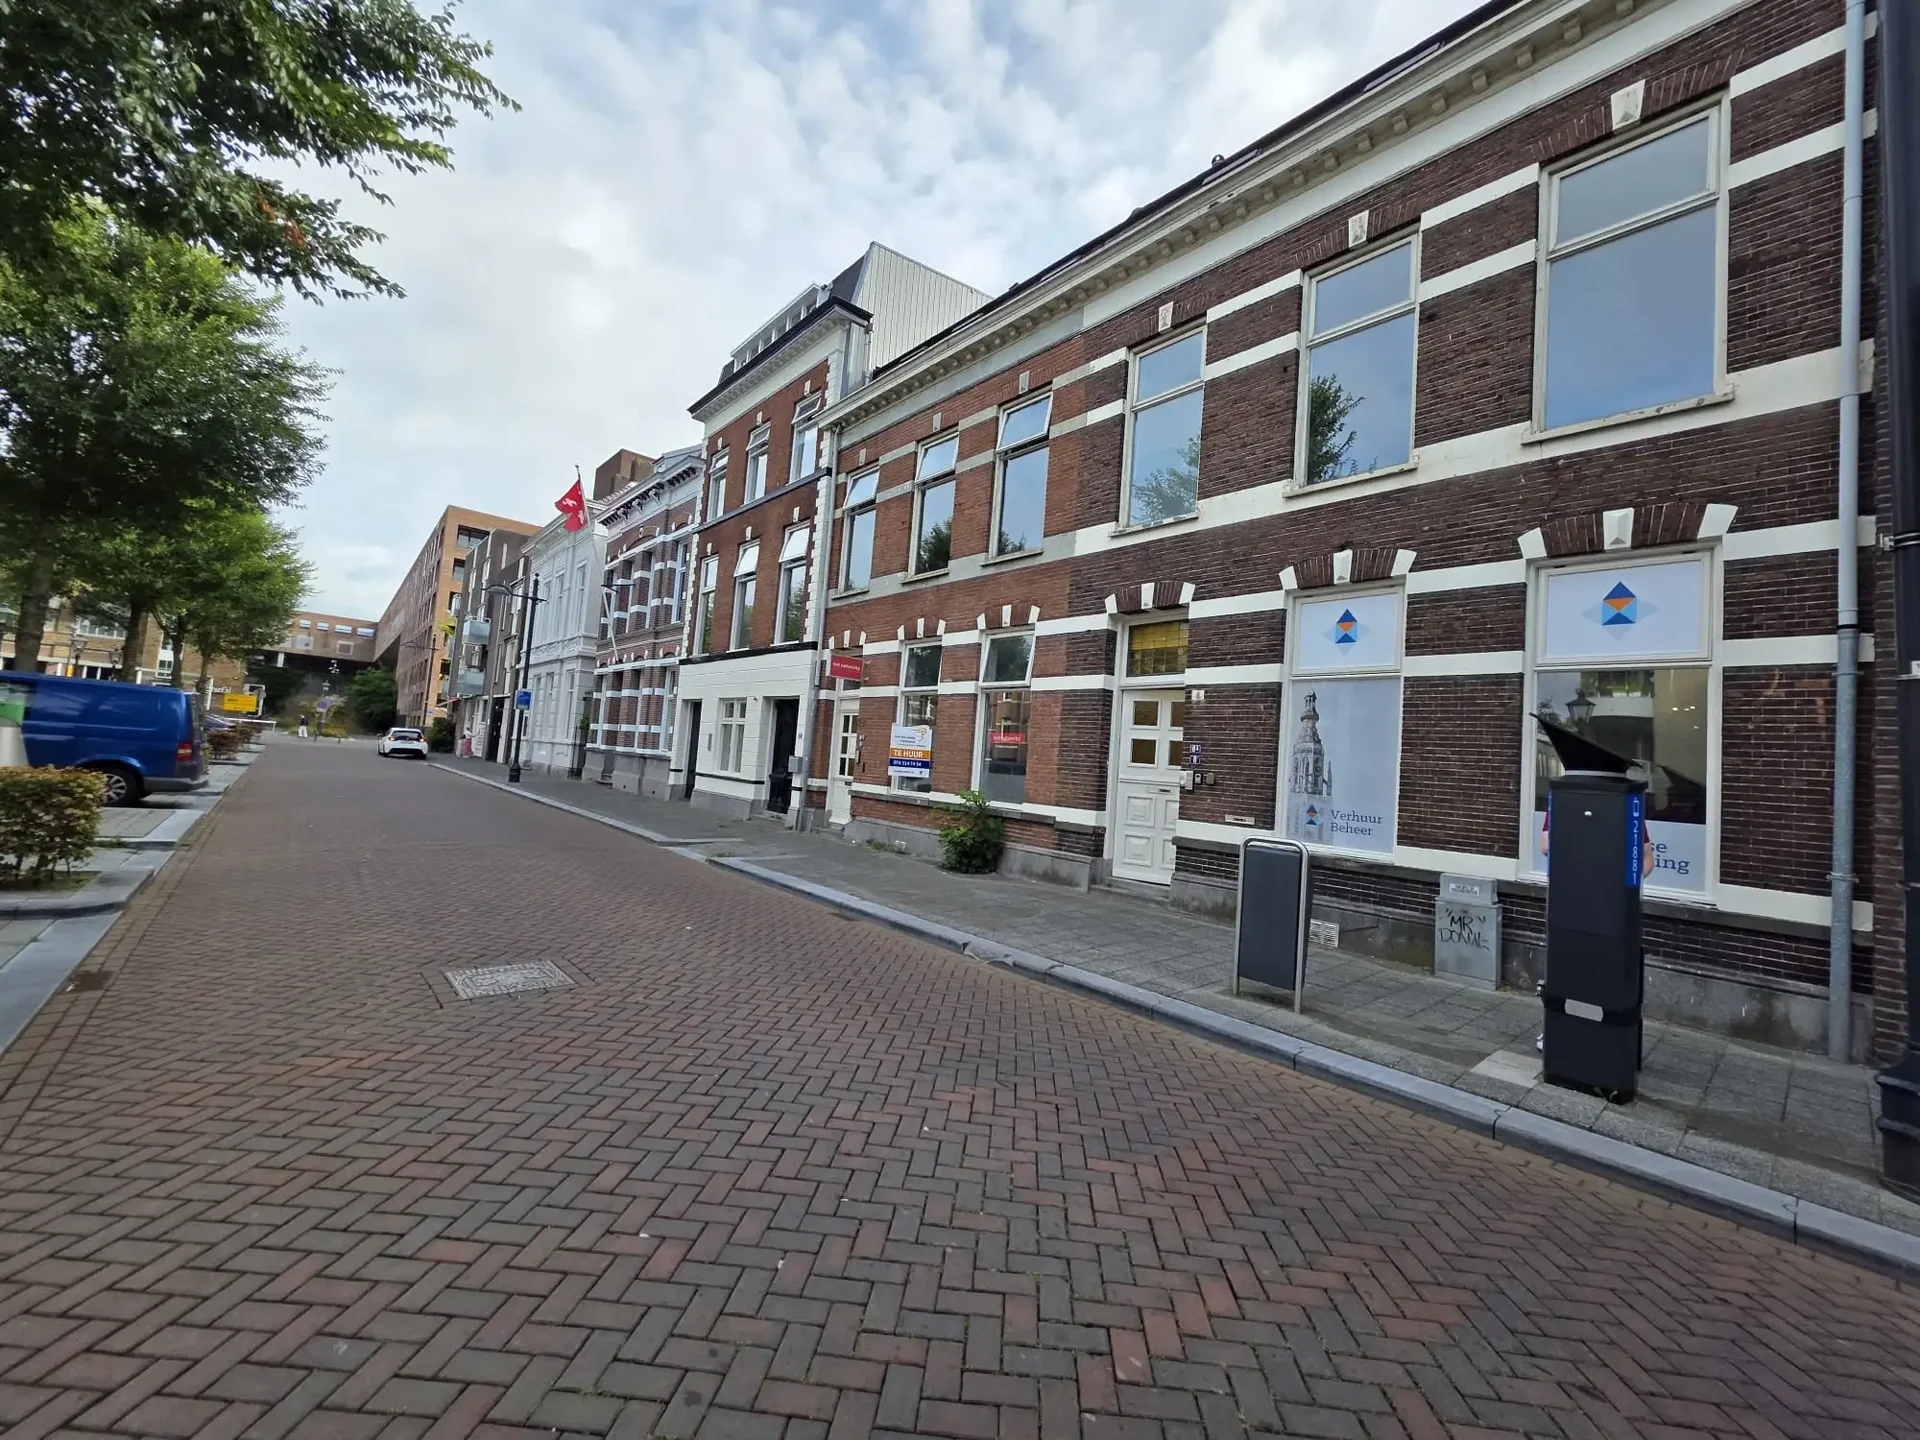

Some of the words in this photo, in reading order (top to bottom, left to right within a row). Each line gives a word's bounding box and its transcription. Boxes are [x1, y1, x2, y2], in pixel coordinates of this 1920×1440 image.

[903, 750, 923, 759] HUUR
[1331, 809, 1383, 824] Verhuur
[1330, 822, 1373, 836] Beheer
